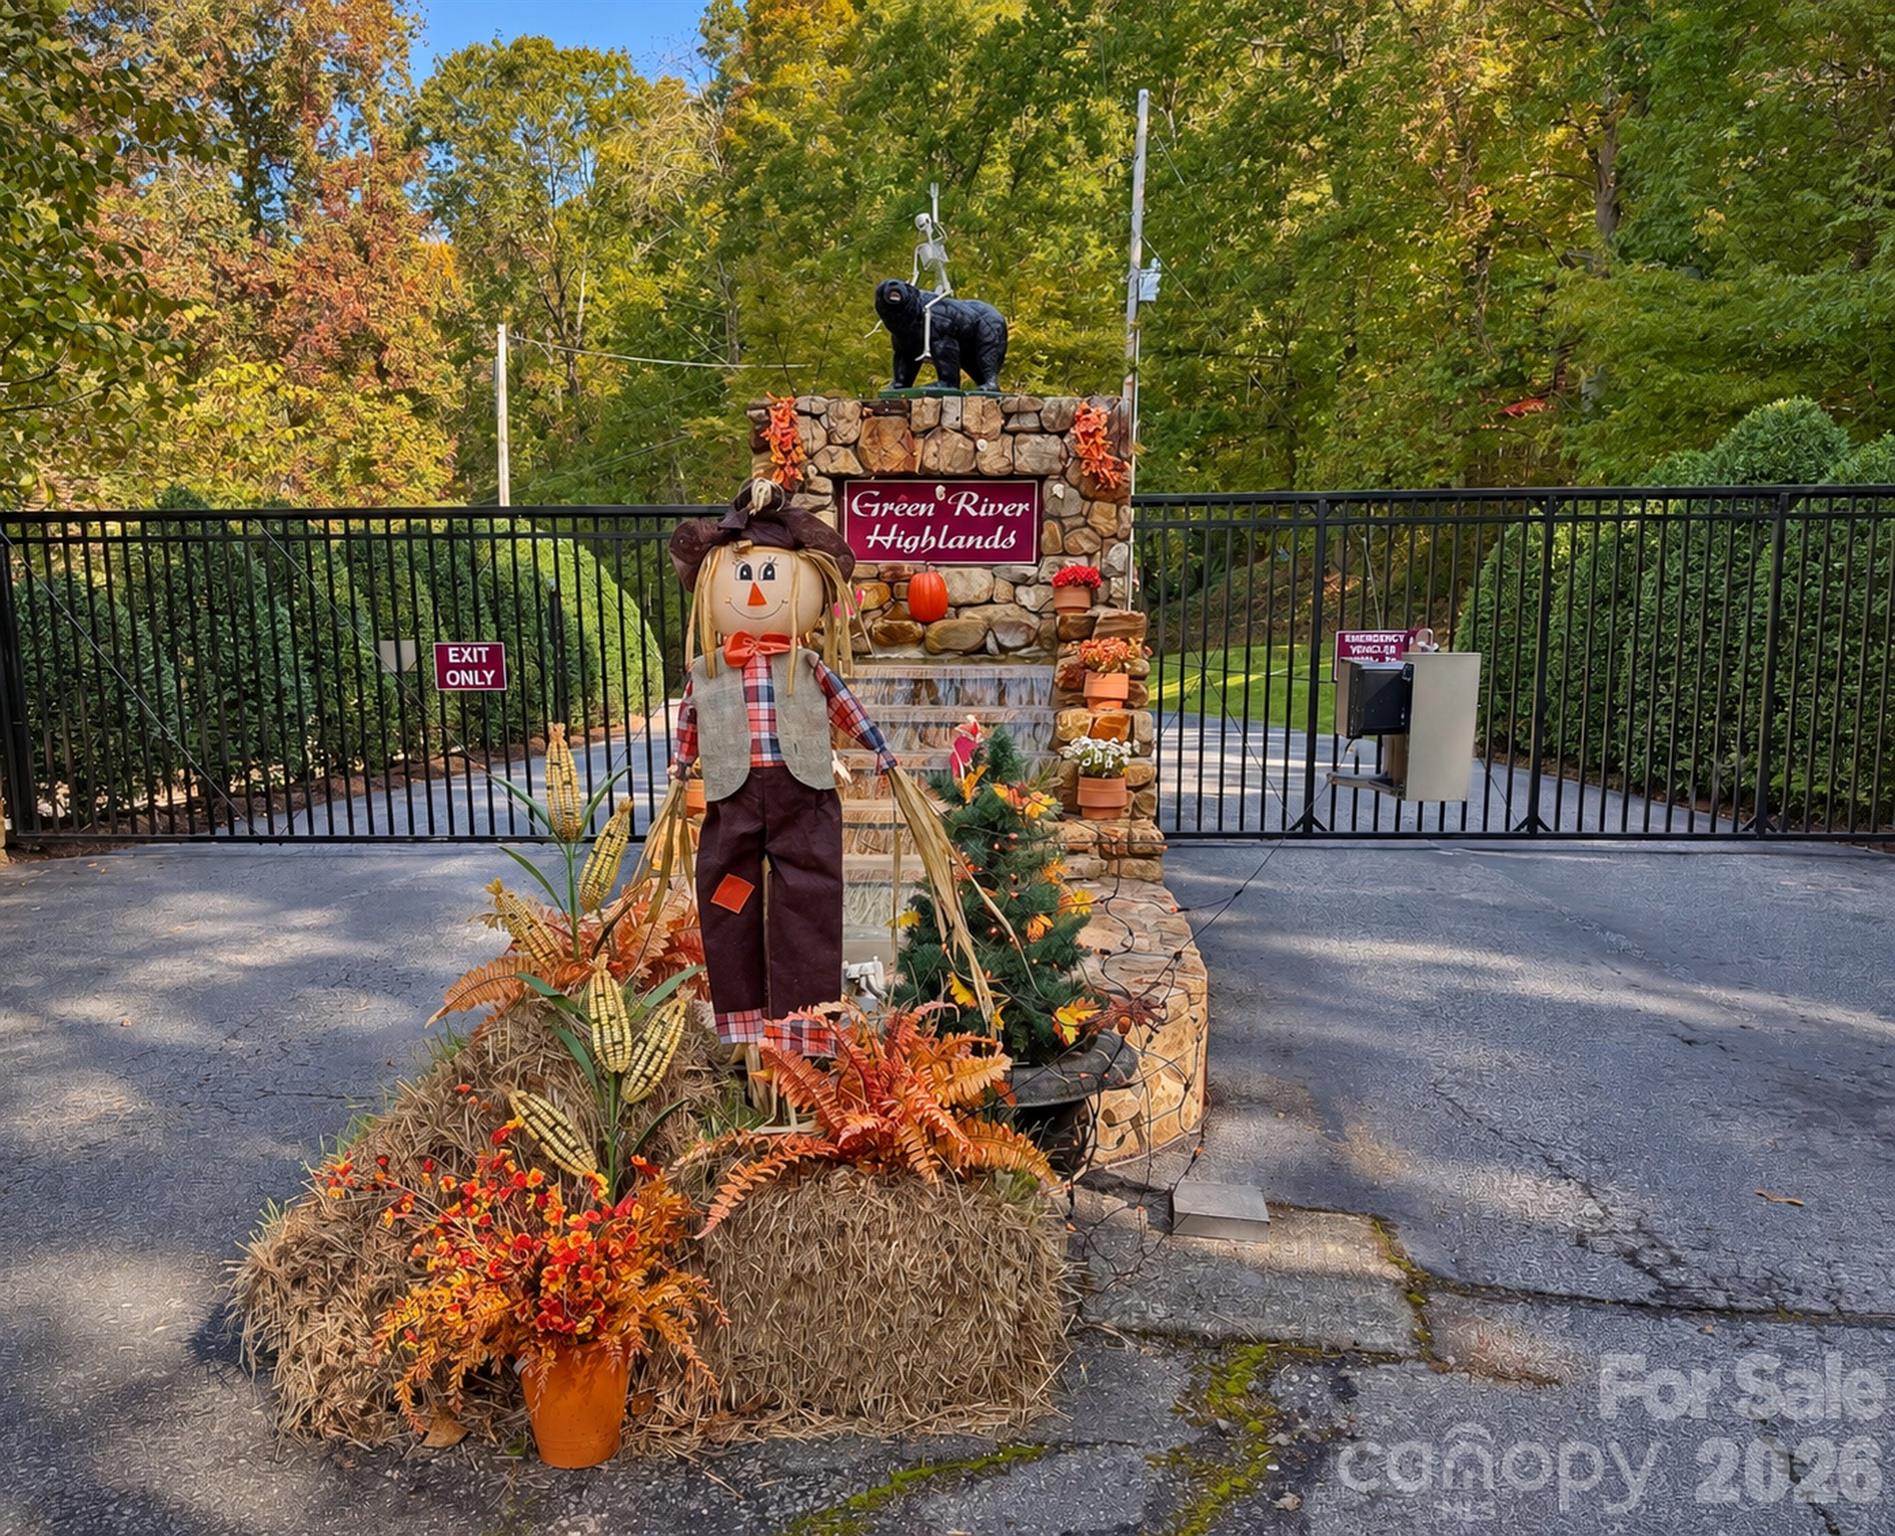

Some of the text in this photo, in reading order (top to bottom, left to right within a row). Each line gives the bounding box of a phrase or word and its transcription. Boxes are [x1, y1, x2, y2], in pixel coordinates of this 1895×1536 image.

[851, 490, 1030, 517] Green River
[866, 523, 1017, 553] Highlands
[1344, 633, 1405, 643] EMERGENCY
[447, 646, 489, 663] EXIT
[445, 669, 496, 686] ONLY
